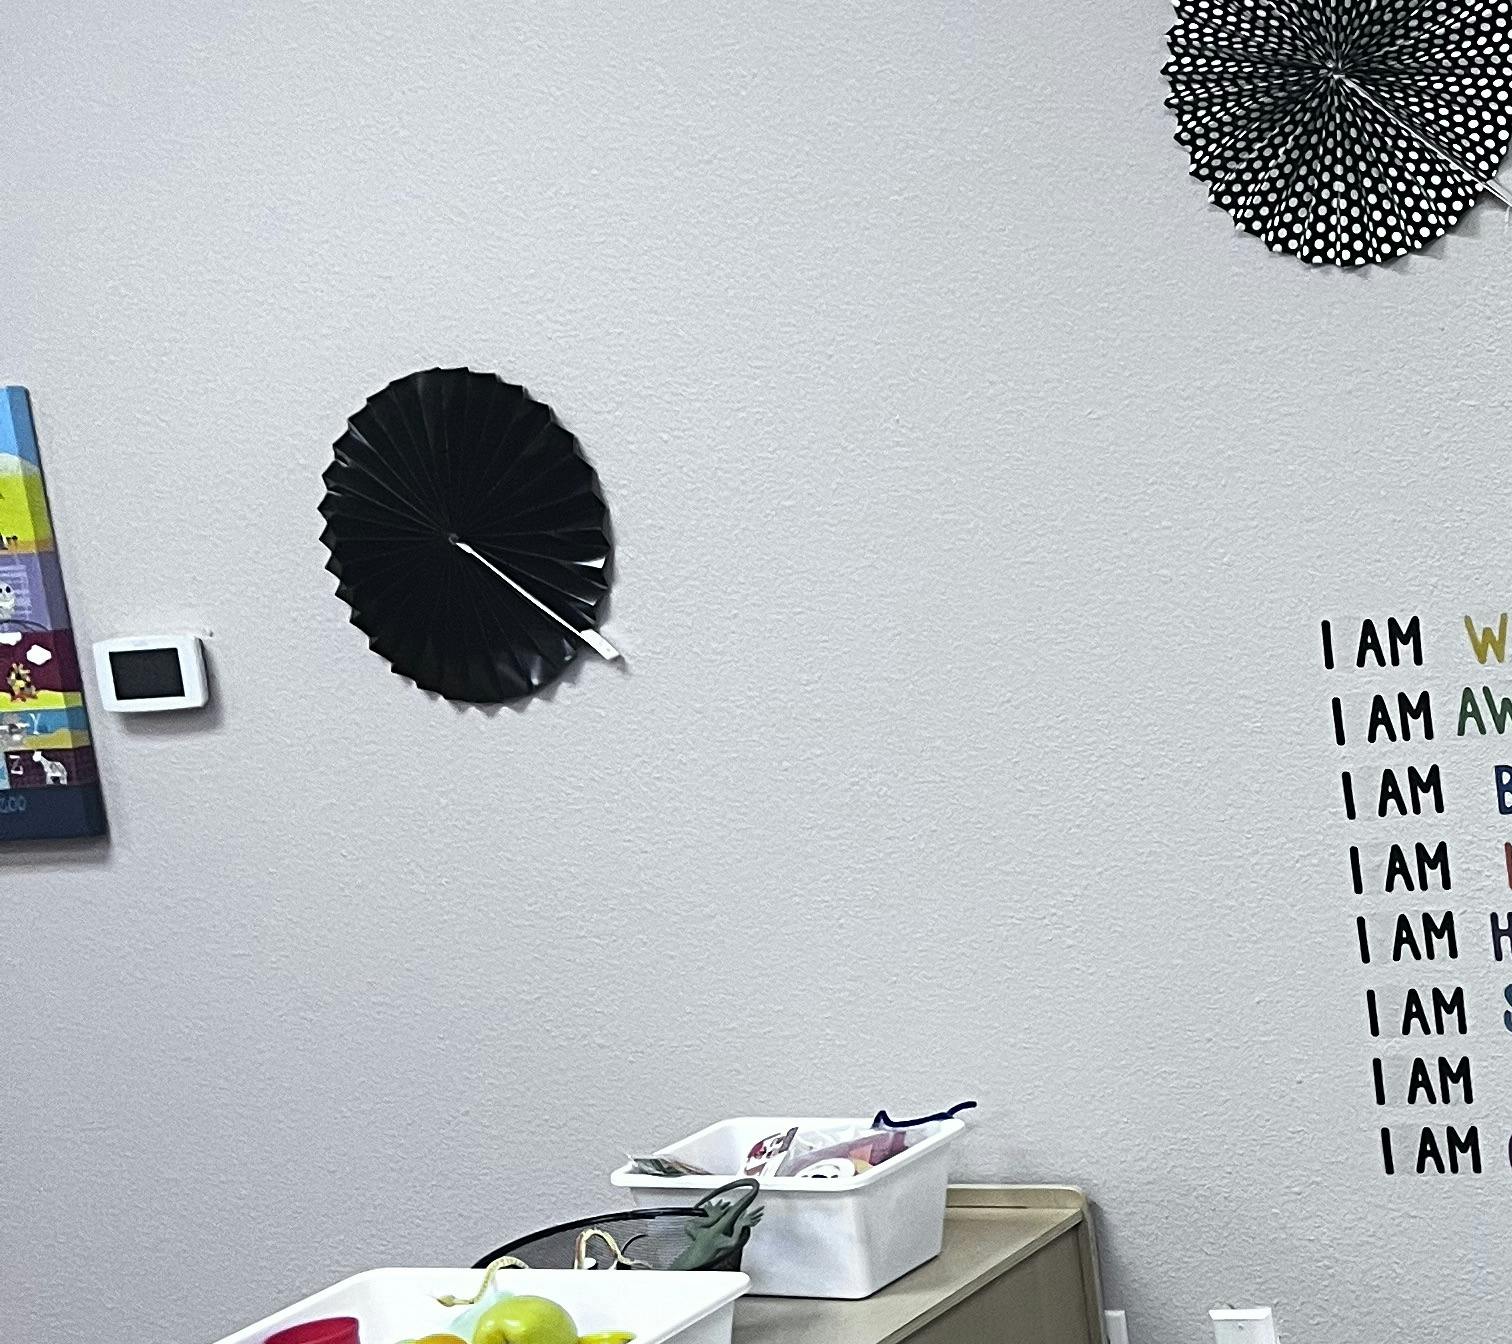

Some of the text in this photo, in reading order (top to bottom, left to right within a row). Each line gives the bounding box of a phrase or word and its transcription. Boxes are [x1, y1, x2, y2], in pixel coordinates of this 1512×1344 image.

[1321, 619, 1334, 670] I
[1356, 615, 1424, 668] AM
[1332, 696, 1346, 746] I
[1367, 690, 1435, 744] AM
[1341, 771, 1356, 821] I
[1377, 764, 1445, 818] AM
[1349, 845, 1363, 895] I
[1384, 840, 1452, 893] AM
[1356, 915, 1371, 964] I
[1392, 910, 1459, 962] AM
[1366, 989, 1380, 1038] I
[1401, 986, 1468, 1036] AM
[1372, 1057, 1386, 1106] I
[1407, 1055, 1474, 1105] AM
[1381, 1126, 1395, 1176] I
[1416, 1125, 1482, 1175] AM
